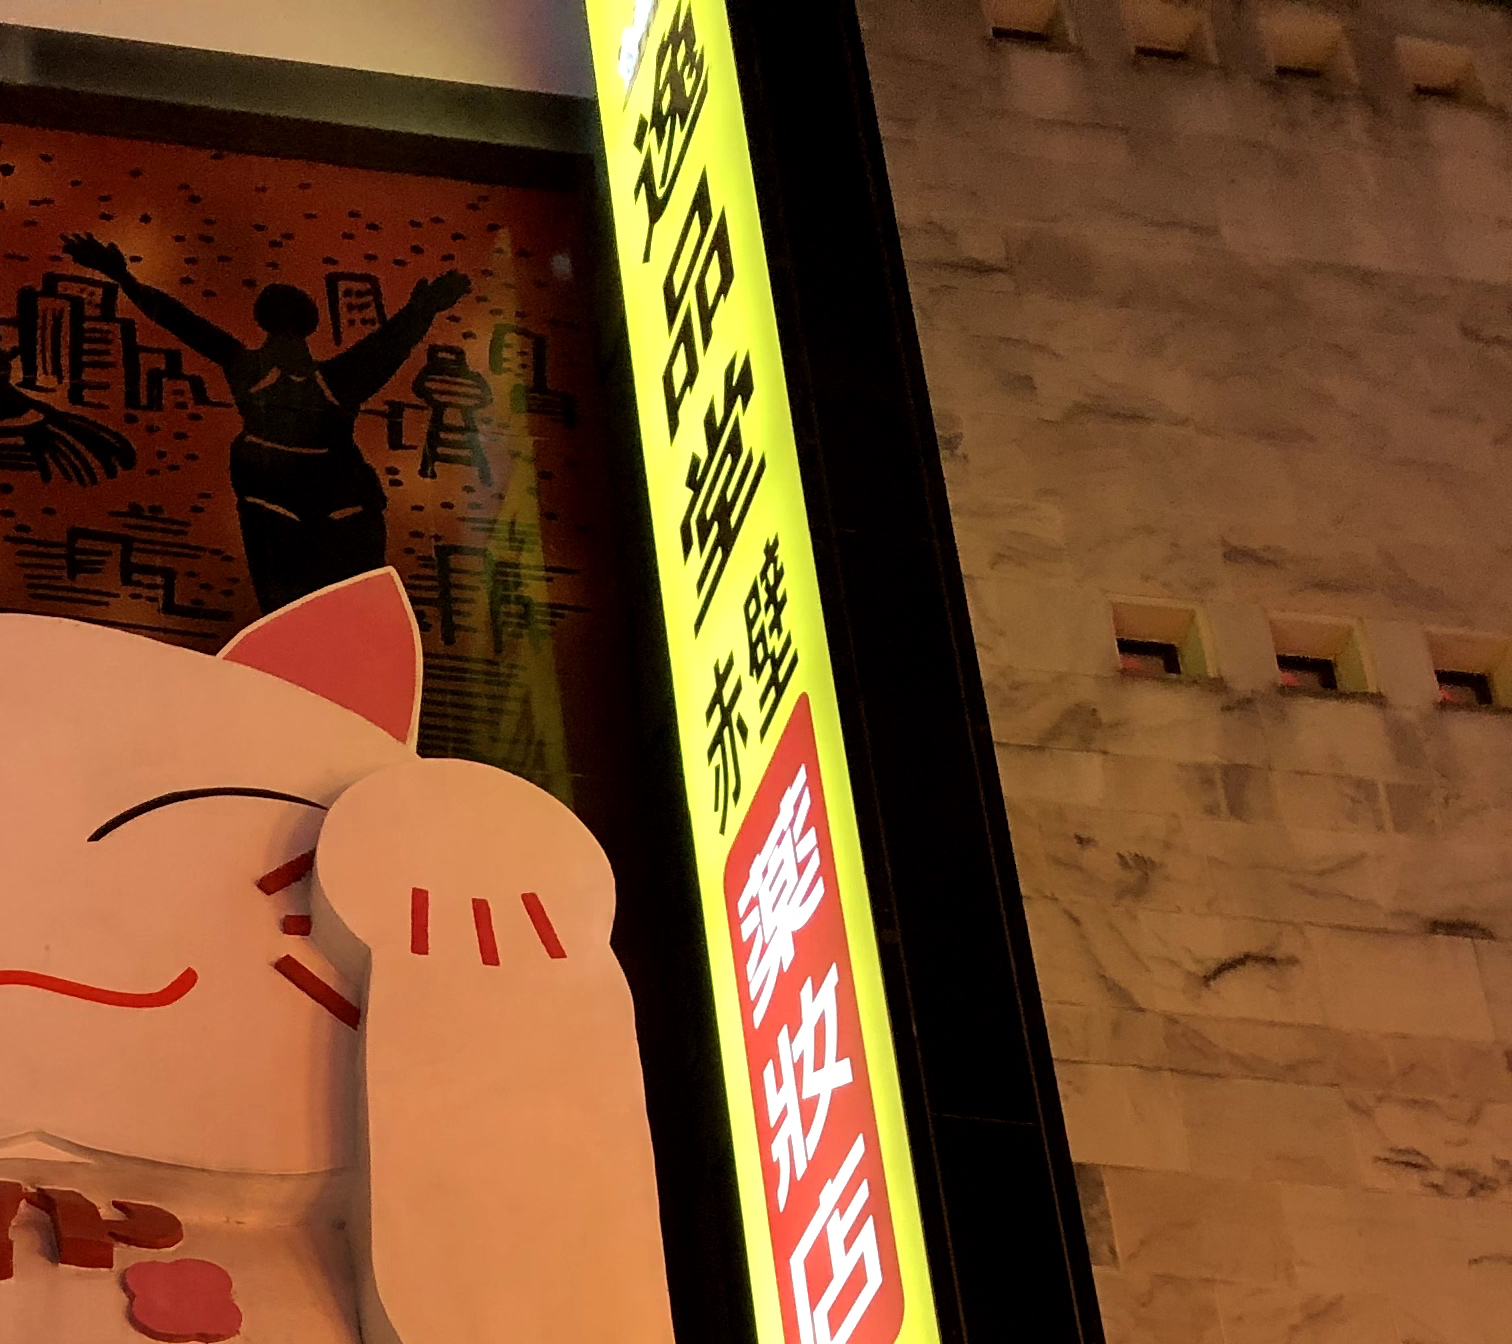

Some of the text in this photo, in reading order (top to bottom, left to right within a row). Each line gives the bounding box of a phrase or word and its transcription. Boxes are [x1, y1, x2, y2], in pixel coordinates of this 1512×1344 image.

[635, 0, 766, 636] 逸品堂
[705, 531, 798, 836] 赤壁
